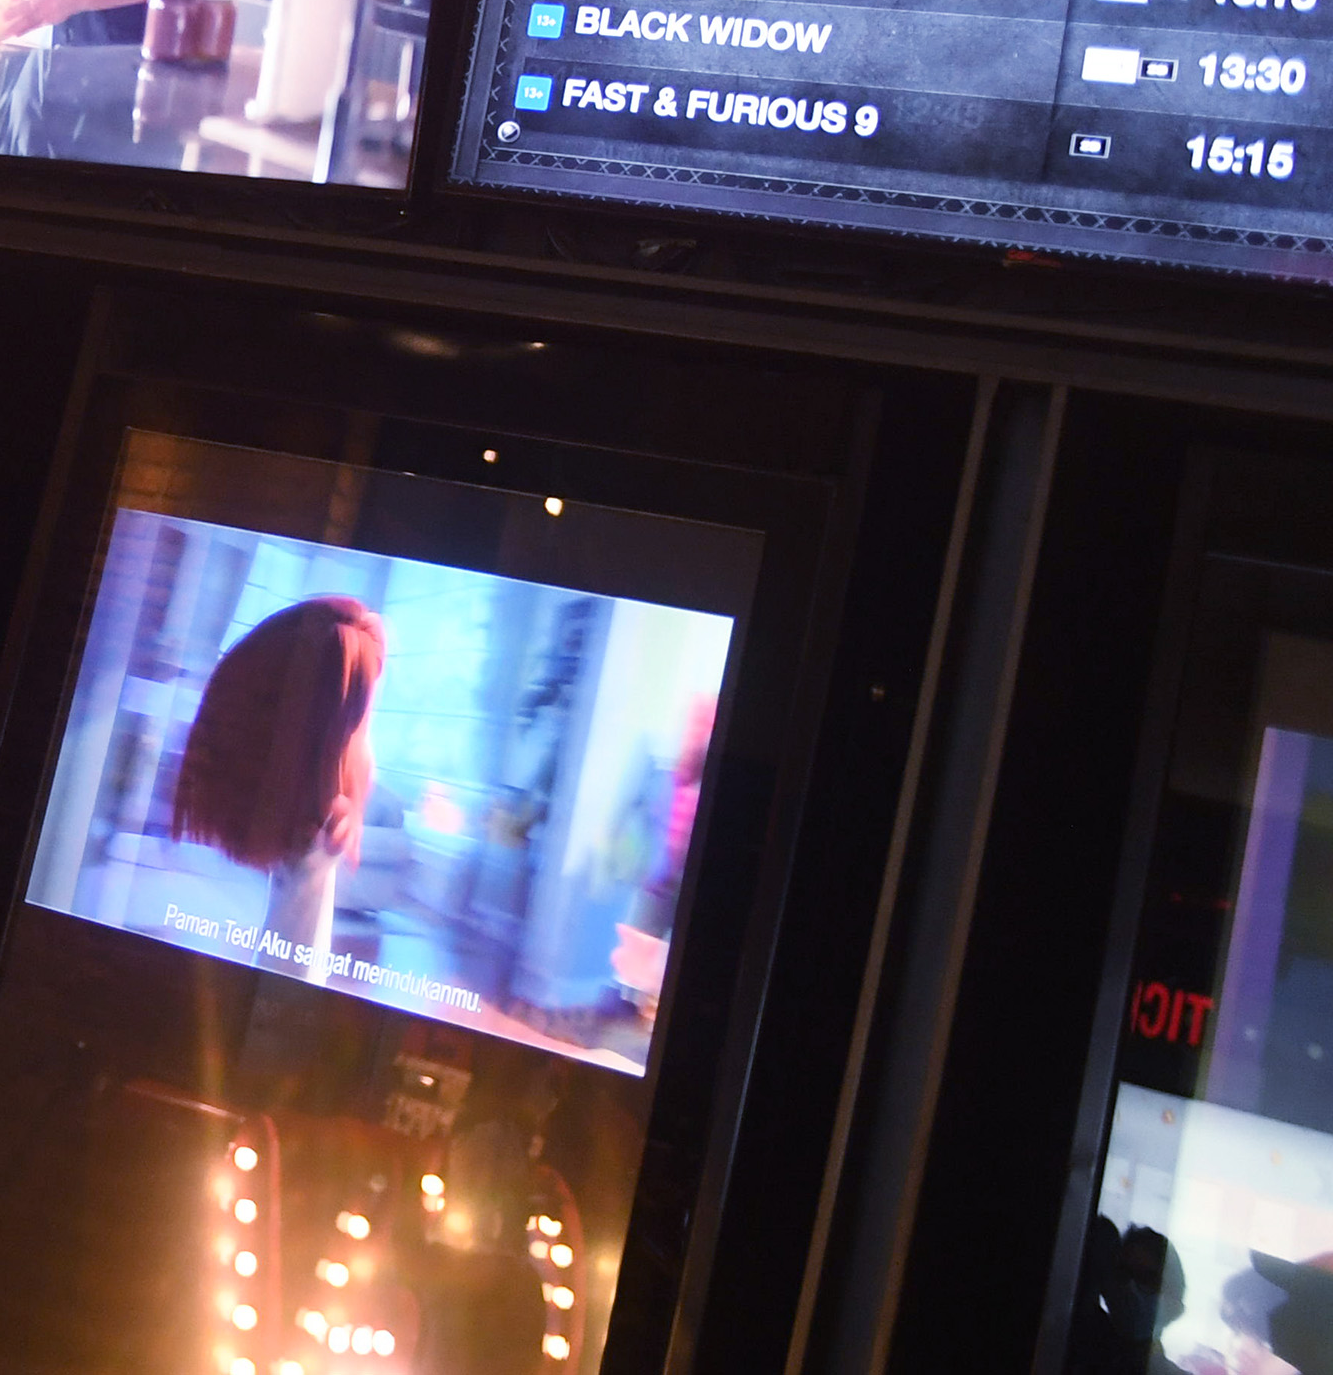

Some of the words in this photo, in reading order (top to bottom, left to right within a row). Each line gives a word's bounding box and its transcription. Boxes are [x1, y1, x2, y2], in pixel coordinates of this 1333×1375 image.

[536, 15, 556, 26] 13+
[574, 5, 694, 43] BLACK
[698, 15, 833, 55] WIDOW
[1198, 51, 1307, 95] 13:30
[523, 86, 544, 98] 13+
[561, 78, 650, 114] FAST
[653, 86, 679, 118] &
[685, 89, 848, 135] FURIOUS
[853, 105, 880, 138] 9
[1186, 133, 1296, 181] 15:15
[163, 903, 220, 940] Paman
[223, 919, 259, 950] Ted!
[257, 929, 292, 960] Aku
[351, 959, 483, 1014] merindukanmu.
